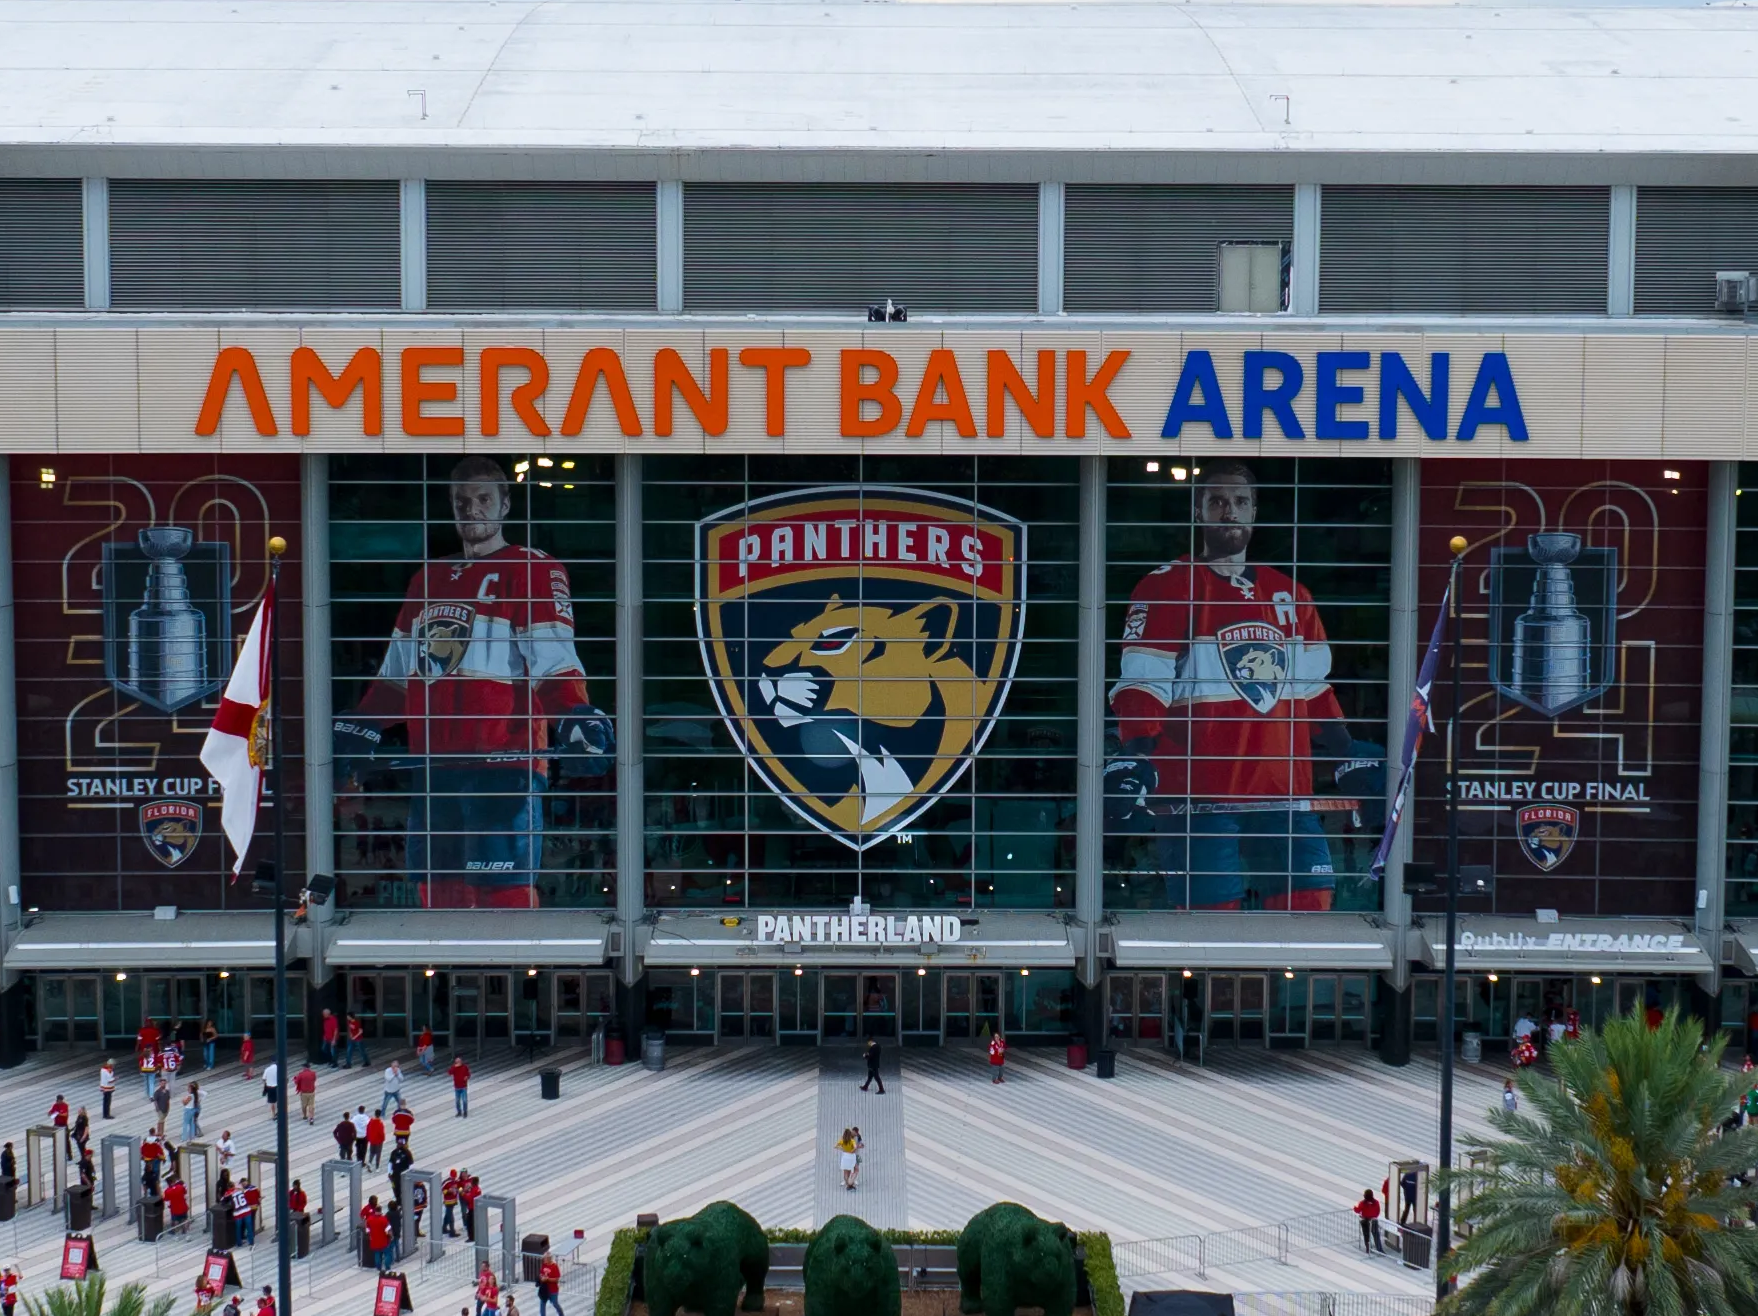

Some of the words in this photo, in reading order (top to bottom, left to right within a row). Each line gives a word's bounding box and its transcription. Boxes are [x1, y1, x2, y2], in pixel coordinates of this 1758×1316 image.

[195, 346, 812, 437] AMERANT
[840, 348, 1131, 438] BANK
[1161, 349, 1530, 442] ARENA
[738, 519, 985, 578] PANTHERS
[66, 778, 158, 797] STANLEY
[162, 779, 203, 797] CUP
[1541, 782, 1581, 800] CUP
[1586, 782, 1652, 801] FINAL
[147, 804, 196, 817] FLORIDA
[1523, 809, 1573, 822] FLORIDA
[757, 915, 962, 943] PANTHERLAND
[1460, 930, 1536, 950] Publix
[1547, 933, 1685, 953] ENTRANCE
[232, 1192, 247, 1208] 16
